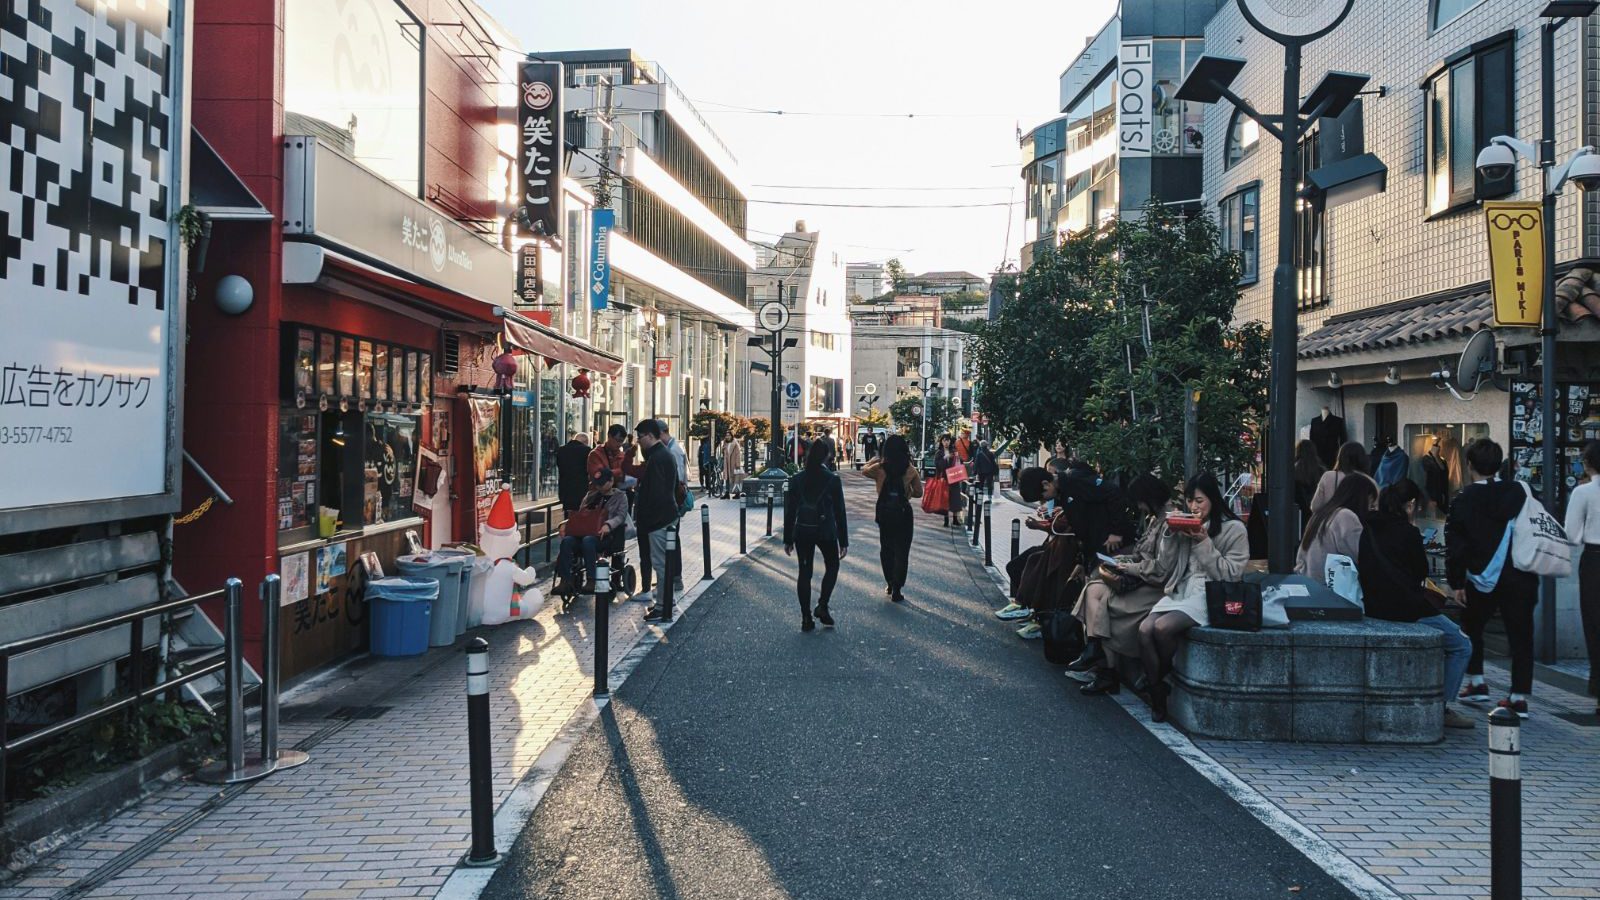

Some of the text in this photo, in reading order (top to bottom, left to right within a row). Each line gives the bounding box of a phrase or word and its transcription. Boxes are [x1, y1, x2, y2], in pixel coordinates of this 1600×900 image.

[1121, 43, 1152, 153] Floats!
[523, 115, 553, 205] 笑たこ
[402, 215, 428, 252] 笑たこ
[593, 226, 607, 281] Columbia
[1513, 230, 1526, 319] PARIS MIKI
[0, 362, 151, 408] 広告をカクサク
[0, 426, 73, 444] 3-5577-4752
